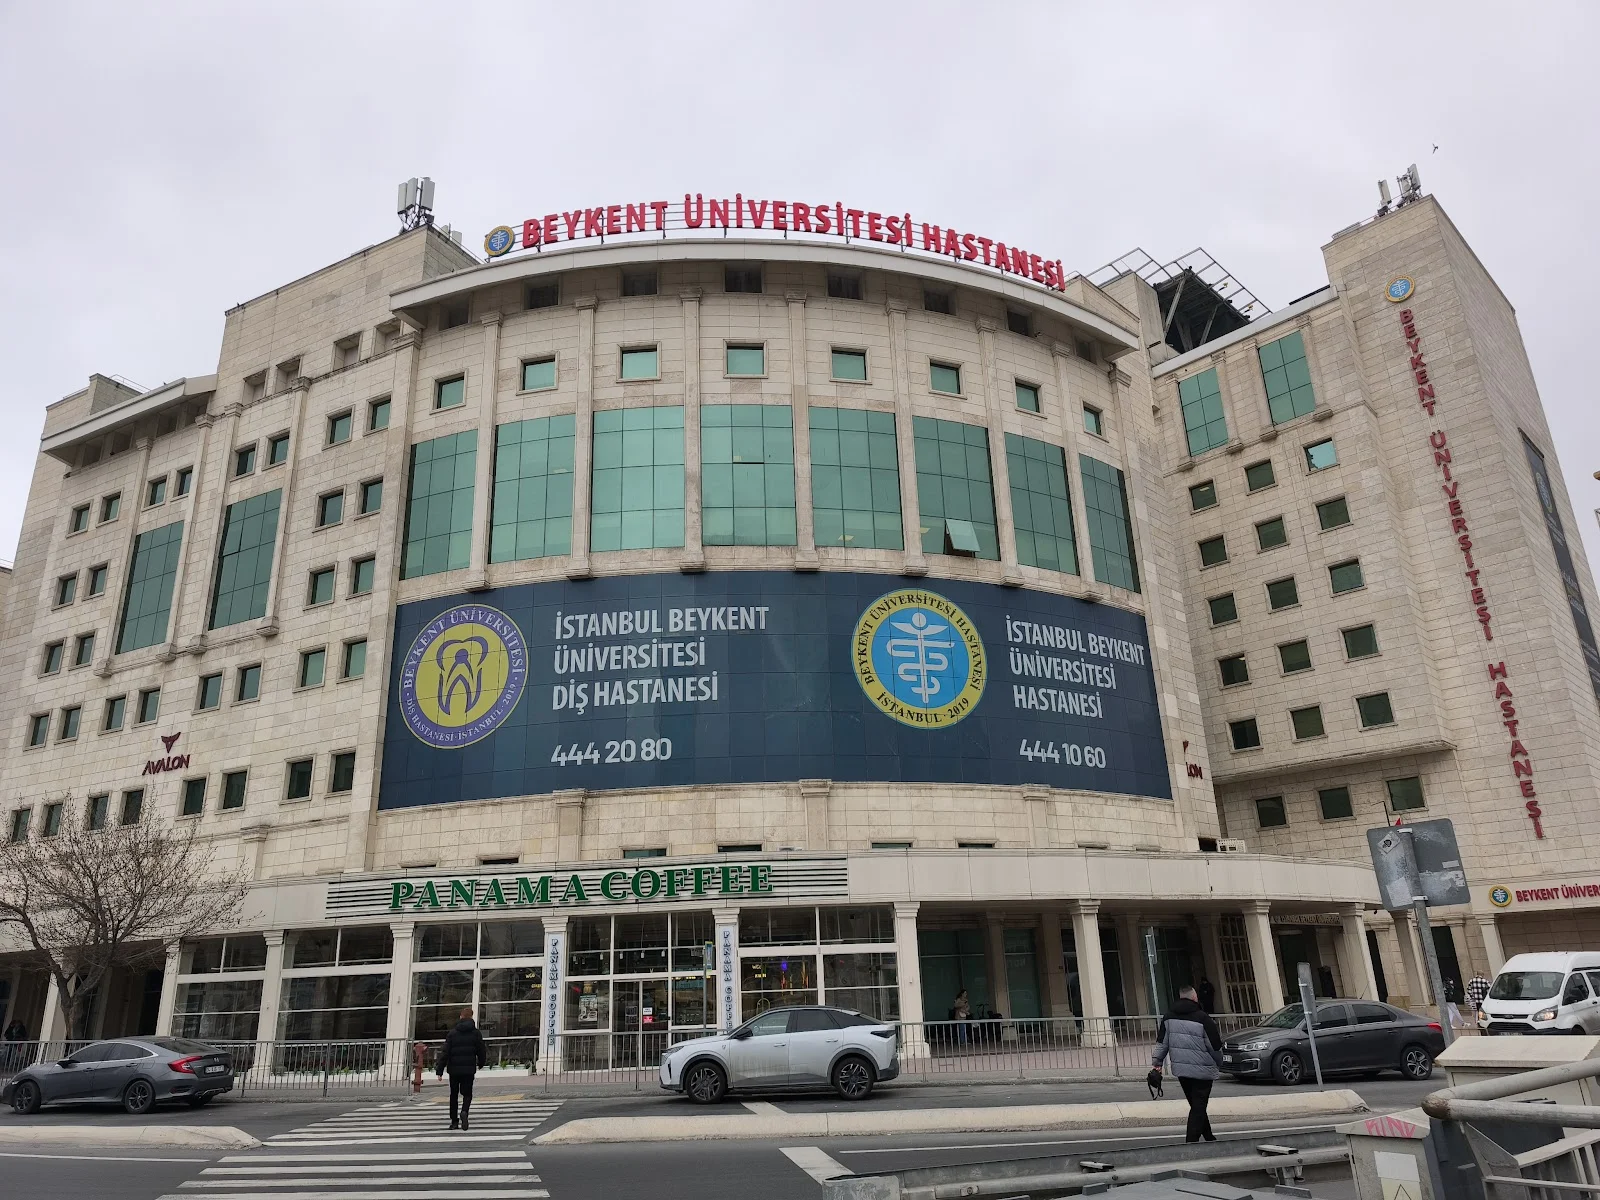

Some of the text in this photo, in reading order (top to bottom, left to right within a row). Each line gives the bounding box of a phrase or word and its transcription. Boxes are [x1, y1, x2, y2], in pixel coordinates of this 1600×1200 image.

[522, 200, 669, 249] BEYKENT
[684, 193, 913, 247] ÜNİVERSİTESİ
[921, 222, 1067, 292] HASTANESİ
[1400, 308, 1436, 416] BEYKENT
[1429, 429, 1493, 641] ÜNİVERSİTESİ
[1487, 661, 1546, 840] HASTANESİ
[555, 606, 769, 640] İSTANBUL BEYKENT
[857, 593, 984, 692] BEYKENT ÜNİVERSİTESİ HASTANESİ
[1005, 614, 1145, 666] İSTANBUL BEYKENT
[403, 607, 526, 689] BEYKENT ÜNİVERSİTESİ
[553, 636, 706, 674] ÜNİVERSİTESİ
[1009, 647, 1117, 690] ÜNİVERSİTESİ
[552, 670, 718, 715] DİŞ HASTANESİ
[876, 691, 969, 724] İSTANBUL 2019
[1013, 684, 1103, 718] HASTANESİ
[406, 697, 416, 716] DİŞ
[411, 714, 454, 742] HASTANESİ
[457, 708, 504, 741] İSTANBUL
[141, 754, 190, 776] AVALON
[550, 737, 672, 767] 444 20 80
[1019, 738, 1107, 769] 444 10 60
[388, 864, 774, 911] PANAMA COFFEE
[1515, 887, 1560, 902] BEYKENT
[549, 939, 558, 989] PANAMA
[723, 931, 732, 981] PANAMA
